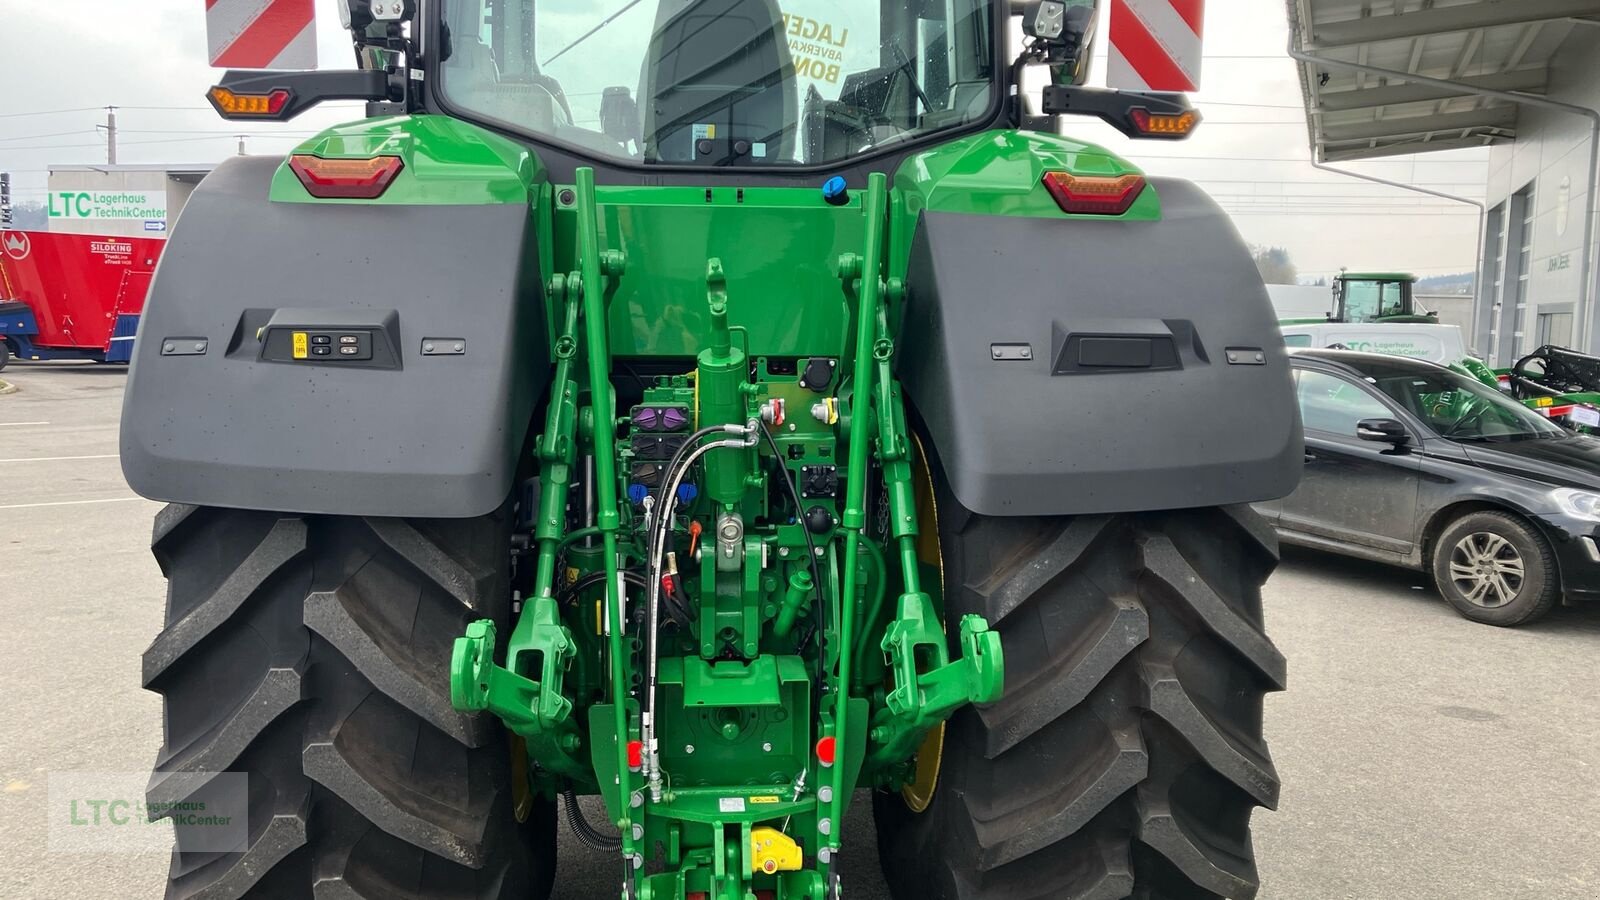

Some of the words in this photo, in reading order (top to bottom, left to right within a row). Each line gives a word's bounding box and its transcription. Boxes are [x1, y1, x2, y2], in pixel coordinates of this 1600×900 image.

[48, 192, 91, 217] LTC
[93, 193, 146, 205] Lagerhaus
[94, 207, 166, 218] TechnikCenter
[90, 243, 132, 252] SILOKING
[1347, 342, 1371, 352] TC
